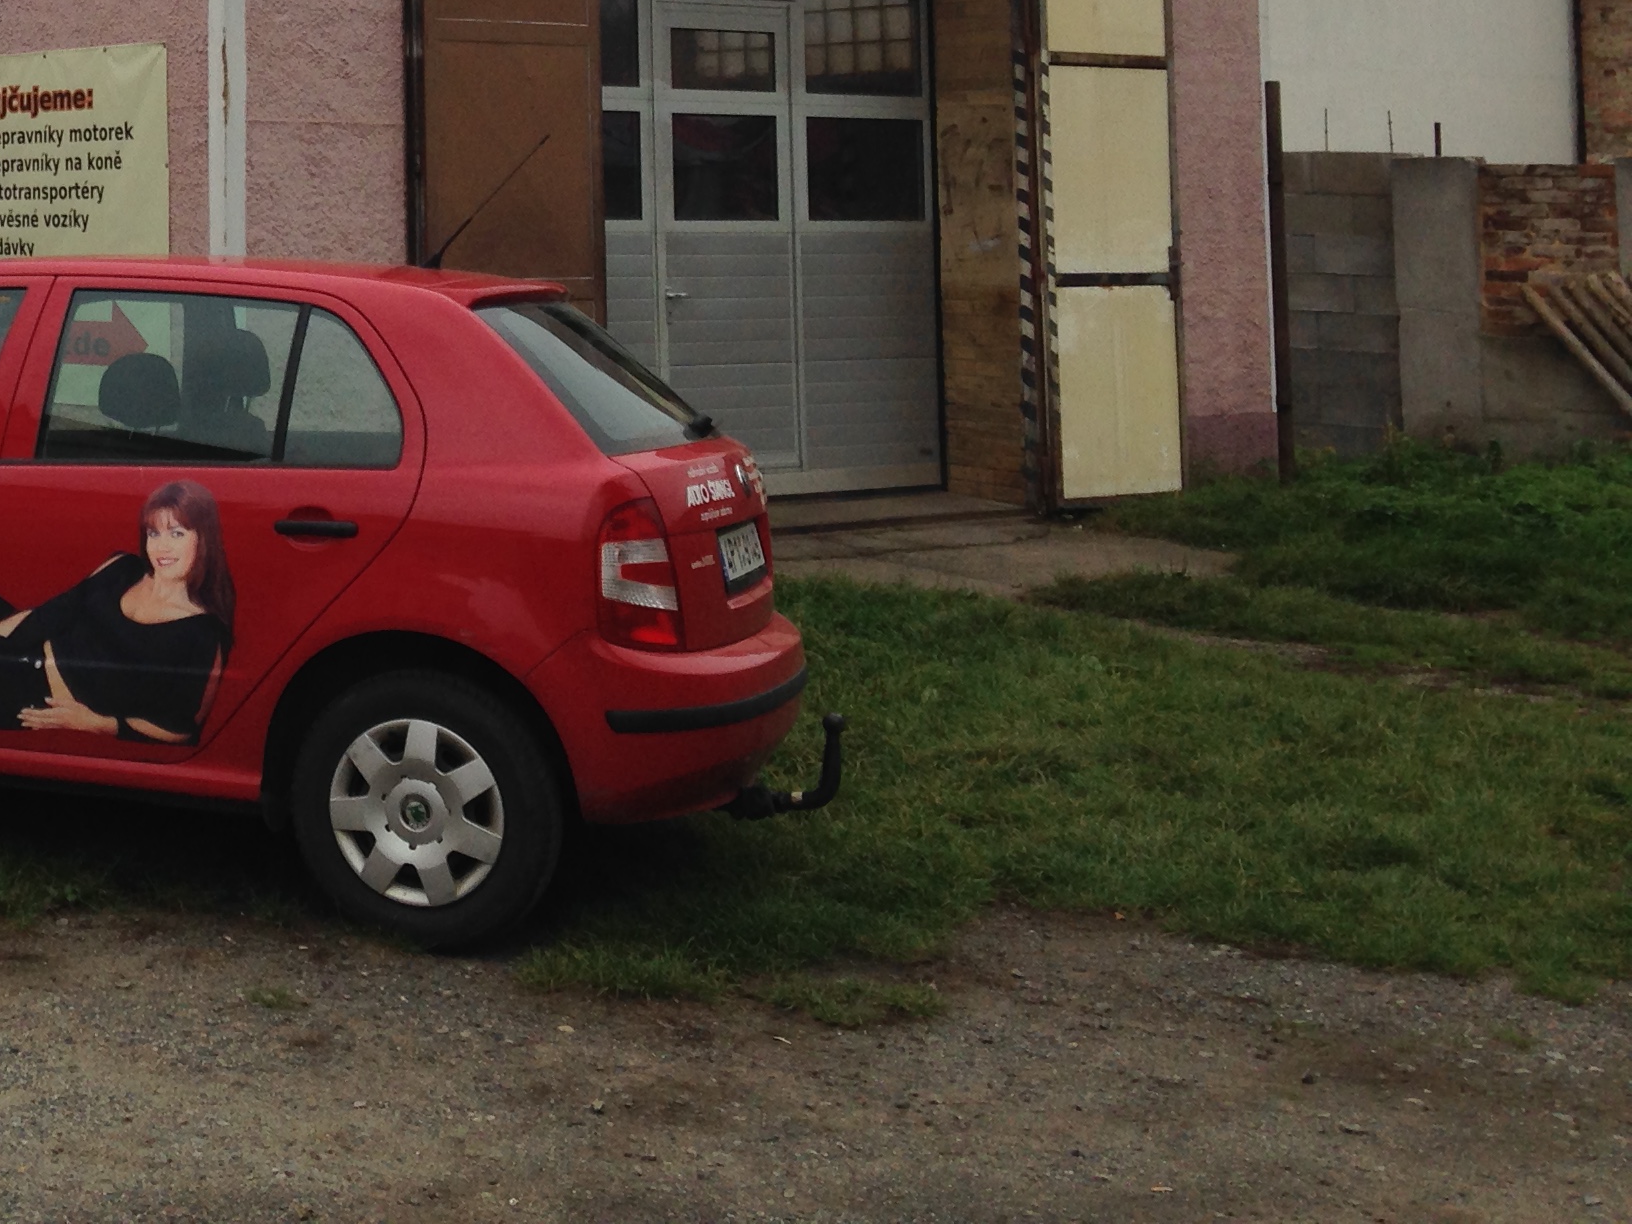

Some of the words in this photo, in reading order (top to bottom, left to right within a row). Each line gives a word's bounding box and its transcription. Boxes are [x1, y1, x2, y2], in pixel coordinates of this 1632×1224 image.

[69, 121, 134, 144] motorek
[65, 157, 83, 172] na
[87, 149, 122, 171] koně
[44, 207, 90, 232] vozíky
